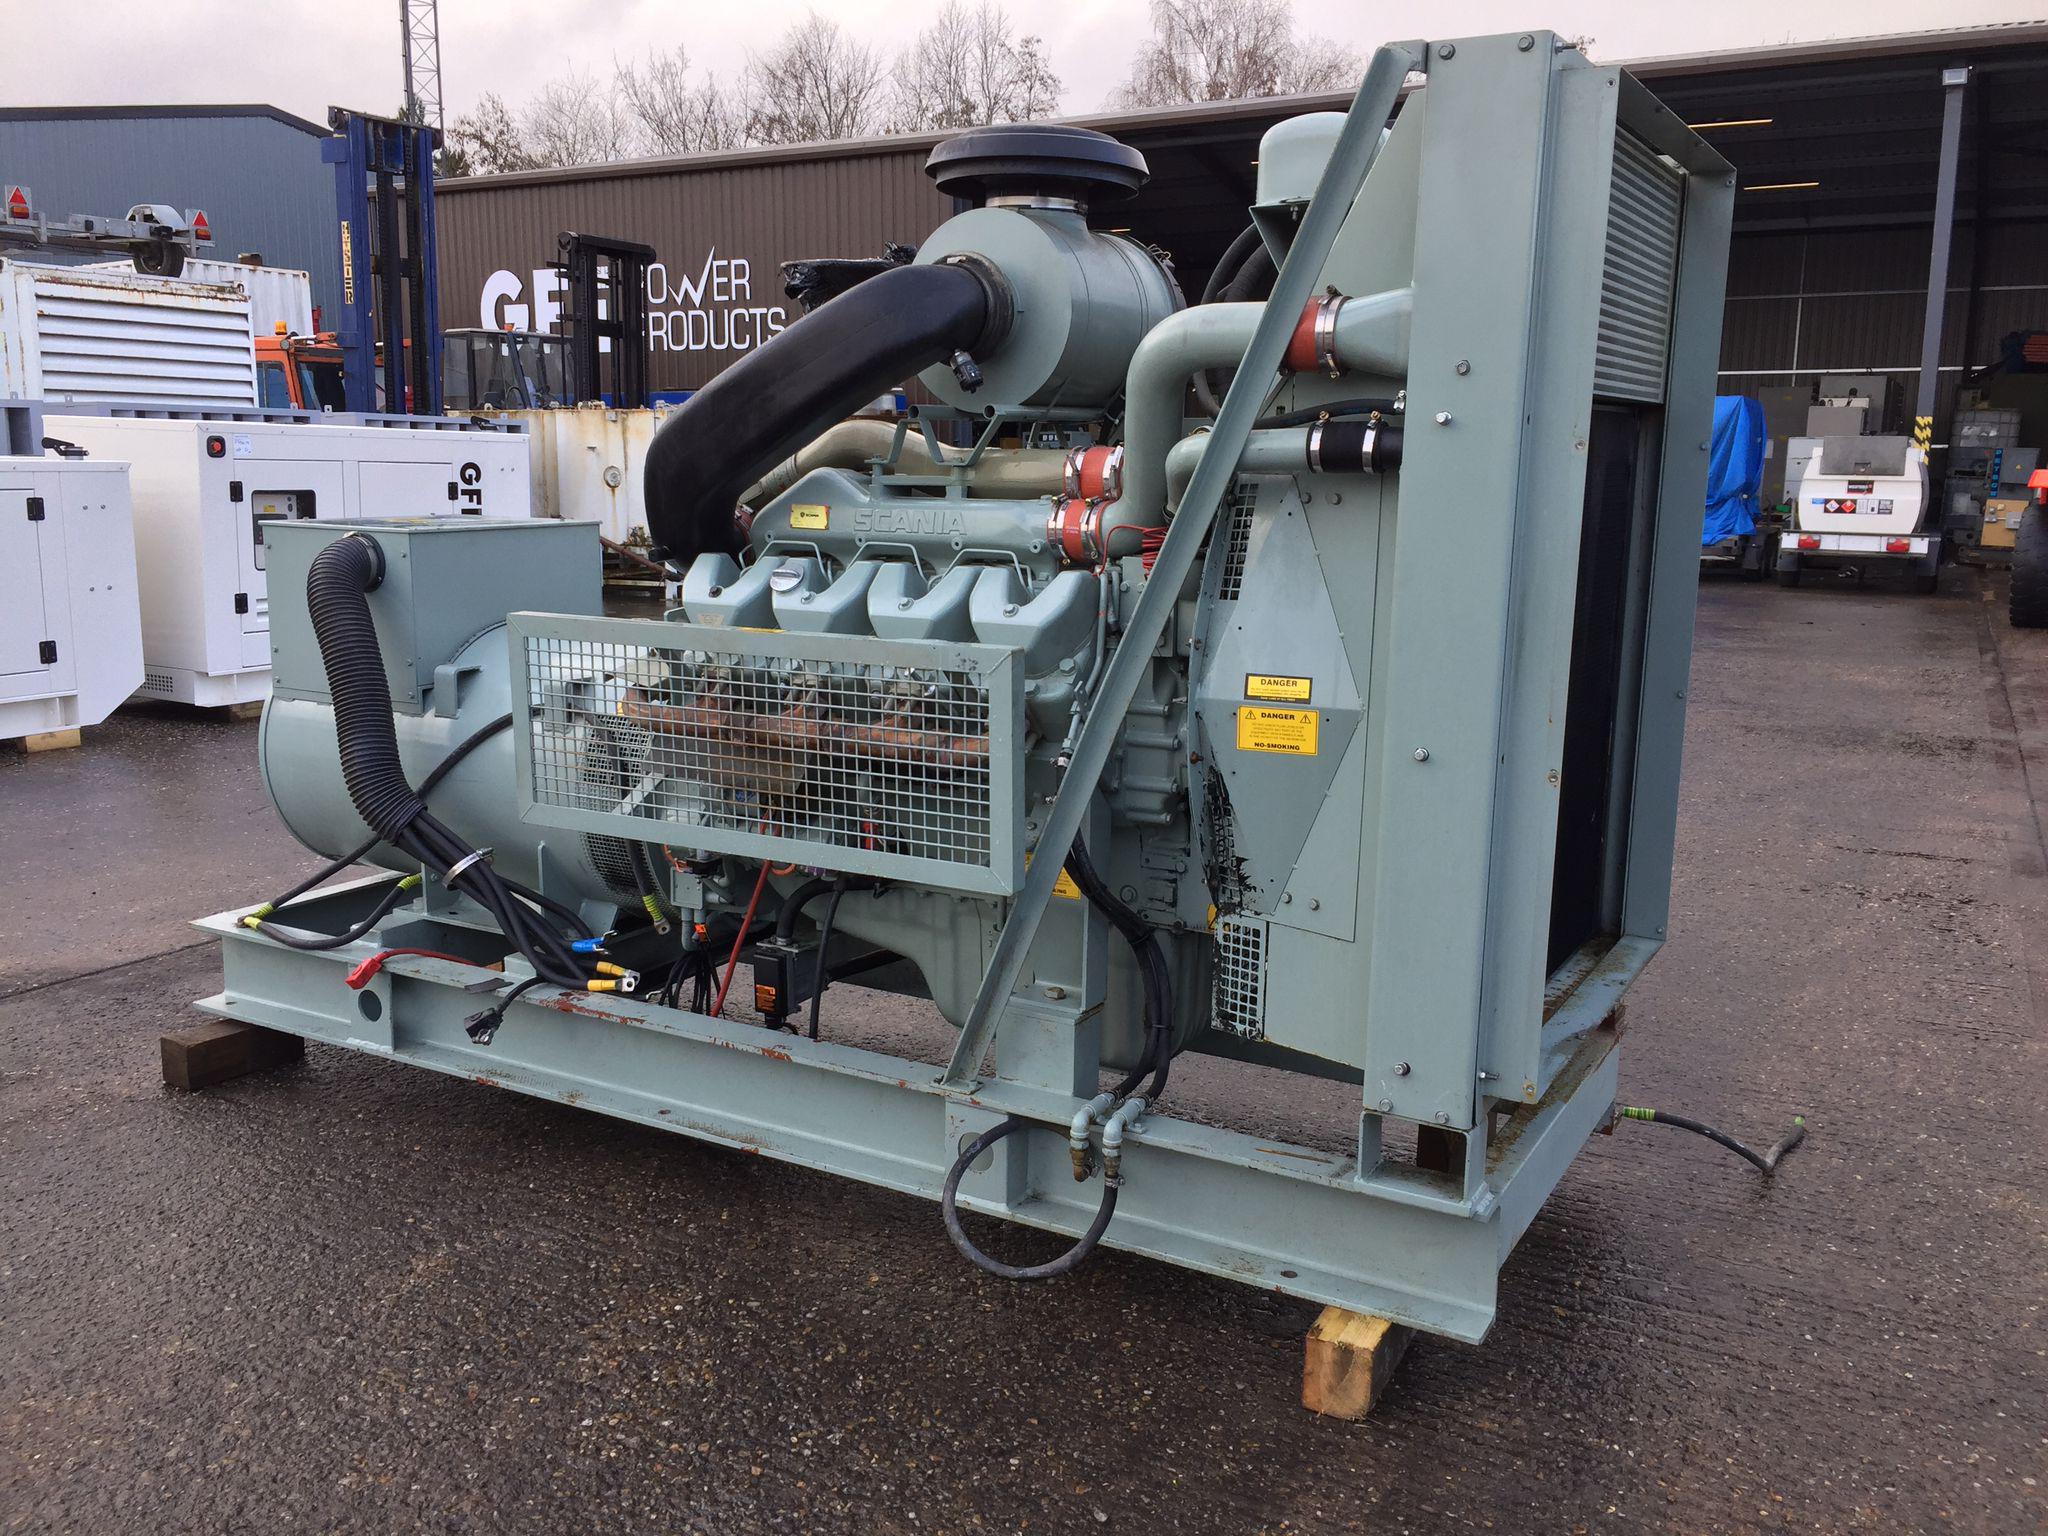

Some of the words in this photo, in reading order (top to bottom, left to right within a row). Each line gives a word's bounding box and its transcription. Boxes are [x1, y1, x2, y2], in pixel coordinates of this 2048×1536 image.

[641, 245, 750, 308] OWER
[641, 307, 786, 352] RODUCTS
[853, 508, 967, 536] SCANIA
[1260, 678, 1298, 687] DANGER
[1261, 712, 1296, 721] DANGER
[1254, 742, 1300, 751] NO-SMOKING
